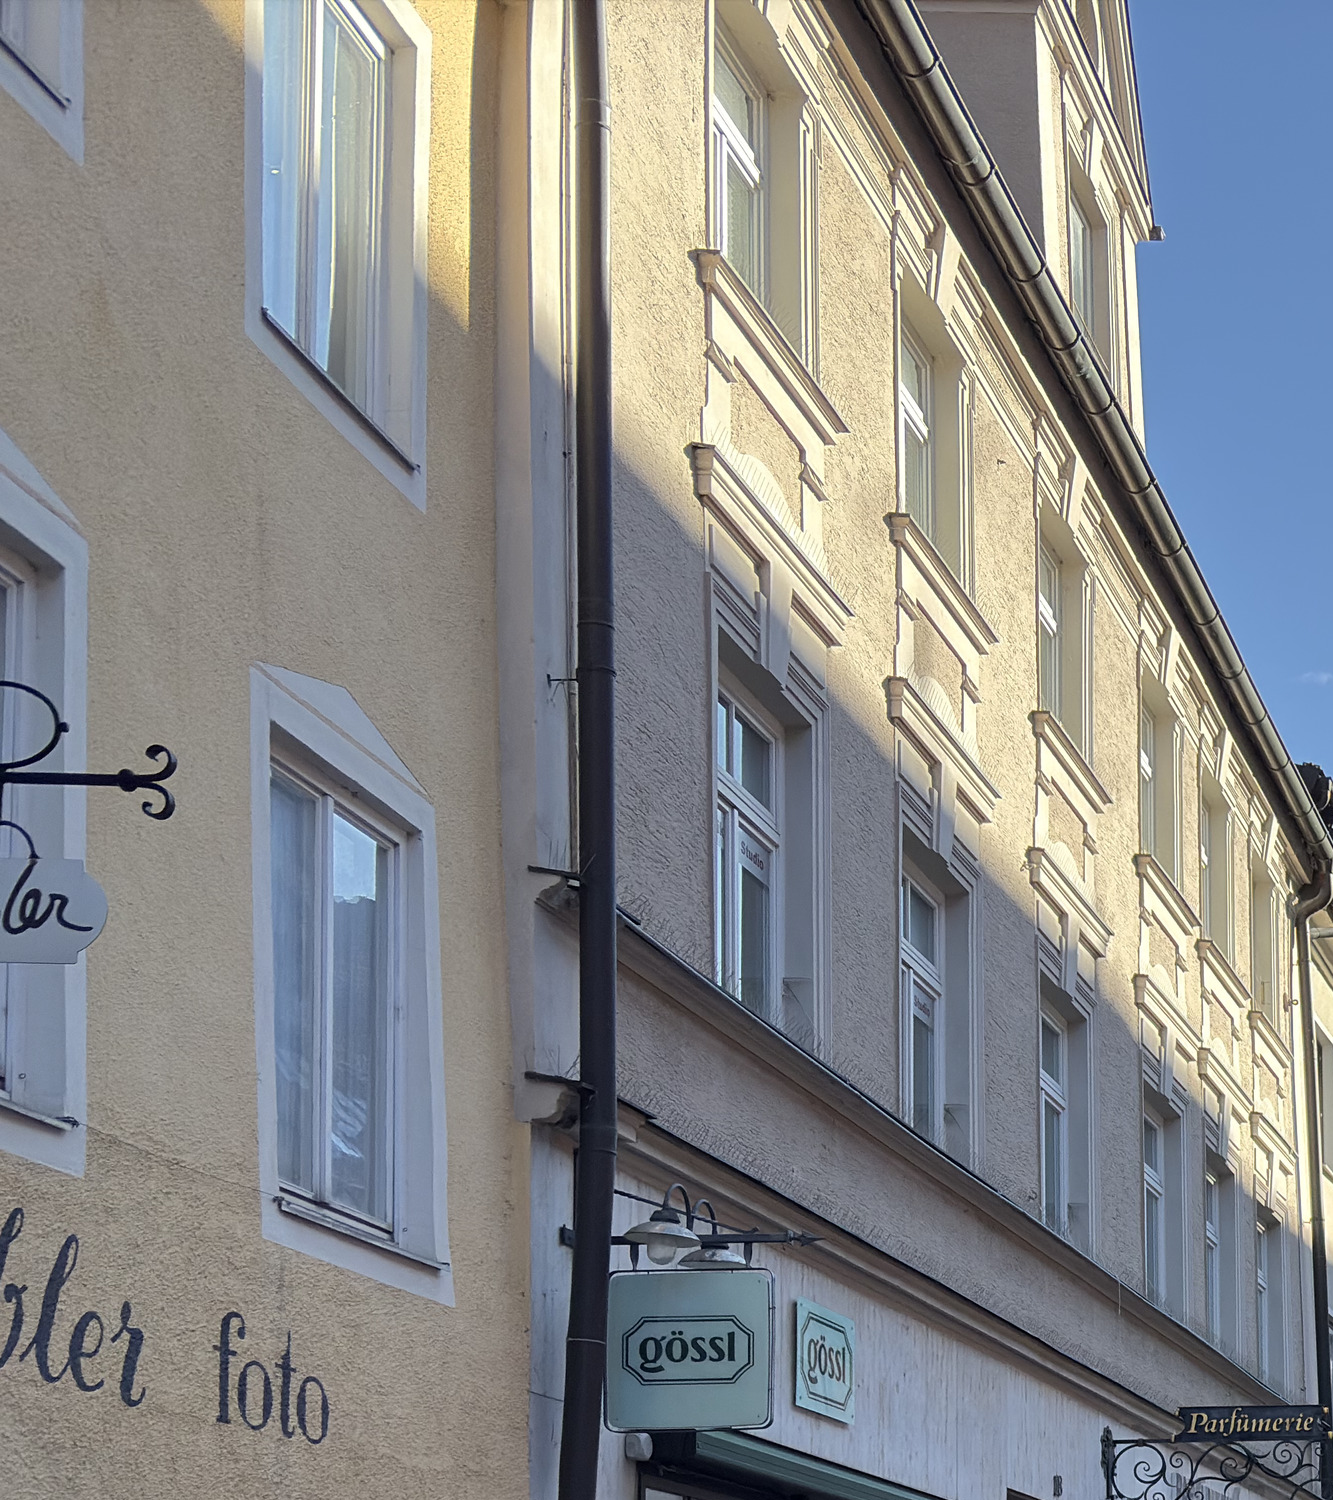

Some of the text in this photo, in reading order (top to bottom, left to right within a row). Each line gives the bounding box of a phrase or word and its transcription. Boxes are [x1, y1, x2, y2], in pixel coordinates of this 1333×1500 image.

[638, 1330, 736, 1374] gössl
[807, 1335, 847, 1385] gössl
[212, 1311, 330, 1445] foto
[1187, 1408, 1314, 1437] Parfümerie
